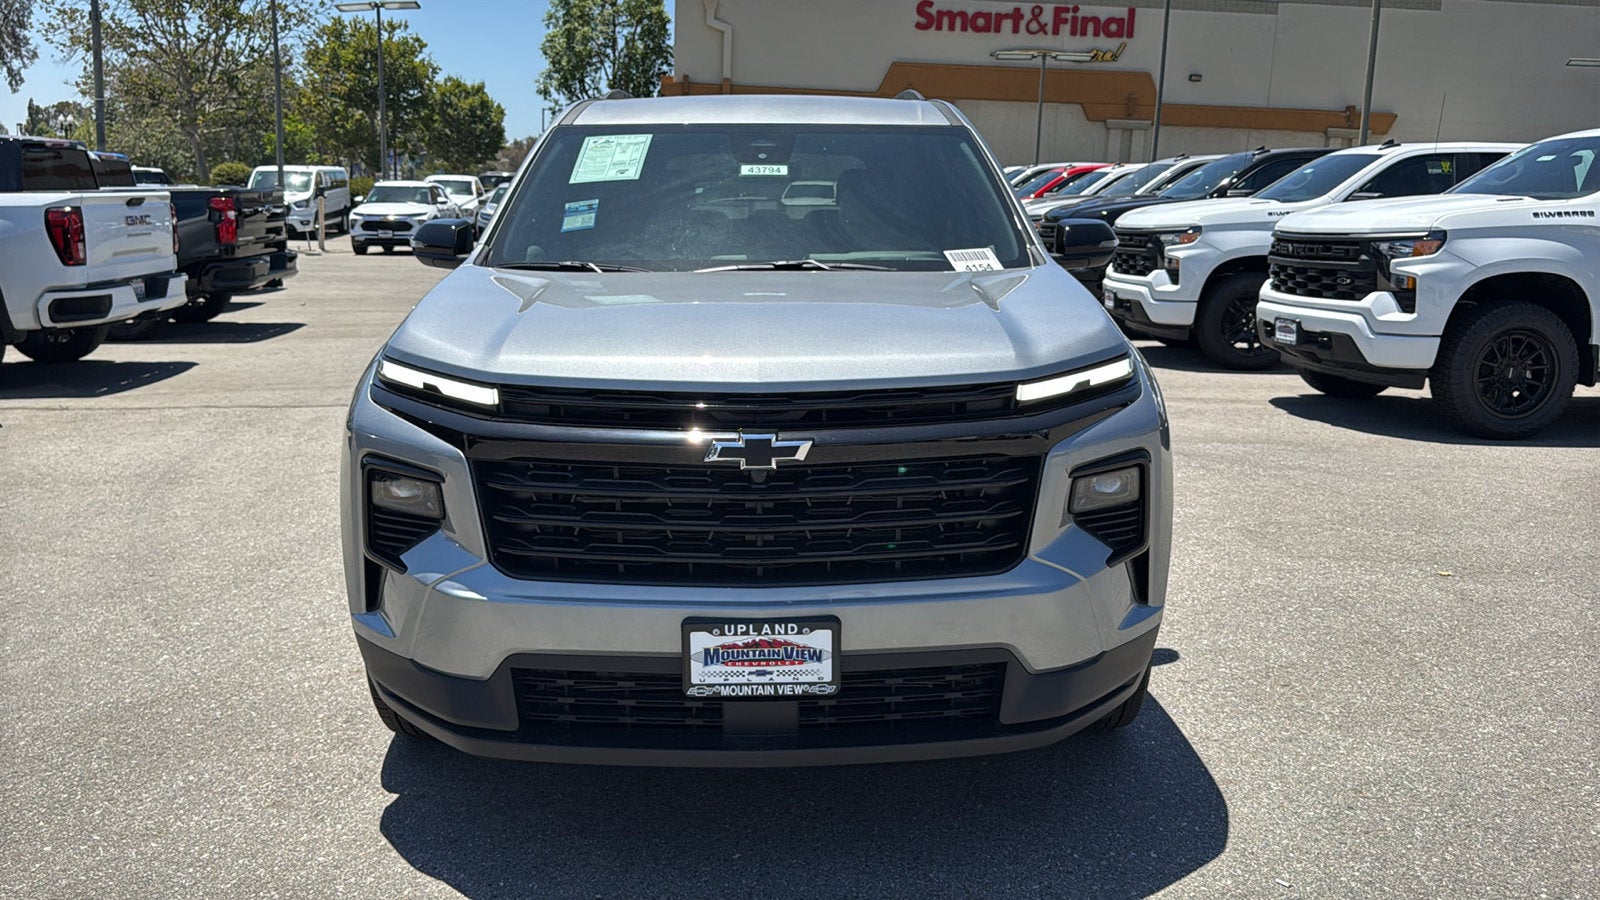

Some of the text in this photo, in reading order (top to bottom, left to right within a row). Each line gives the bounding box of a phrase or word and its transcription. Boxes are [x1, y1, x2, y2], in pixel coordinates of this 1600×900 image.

[914, 0, 1136, 39] Smart&Final
[125, 215, 152, 226] GMC
[1532, 210, 1596, 219] SILVERADO
[965, 263, 994, 272] 4154
[724, 623, 799, 636] UPLAND
[703, 646, 823, 668] MOUNTAIN VIEW
[720, 685, 776, 696] MOUNTAIN
[777, 684, 804, 695] VIEW
